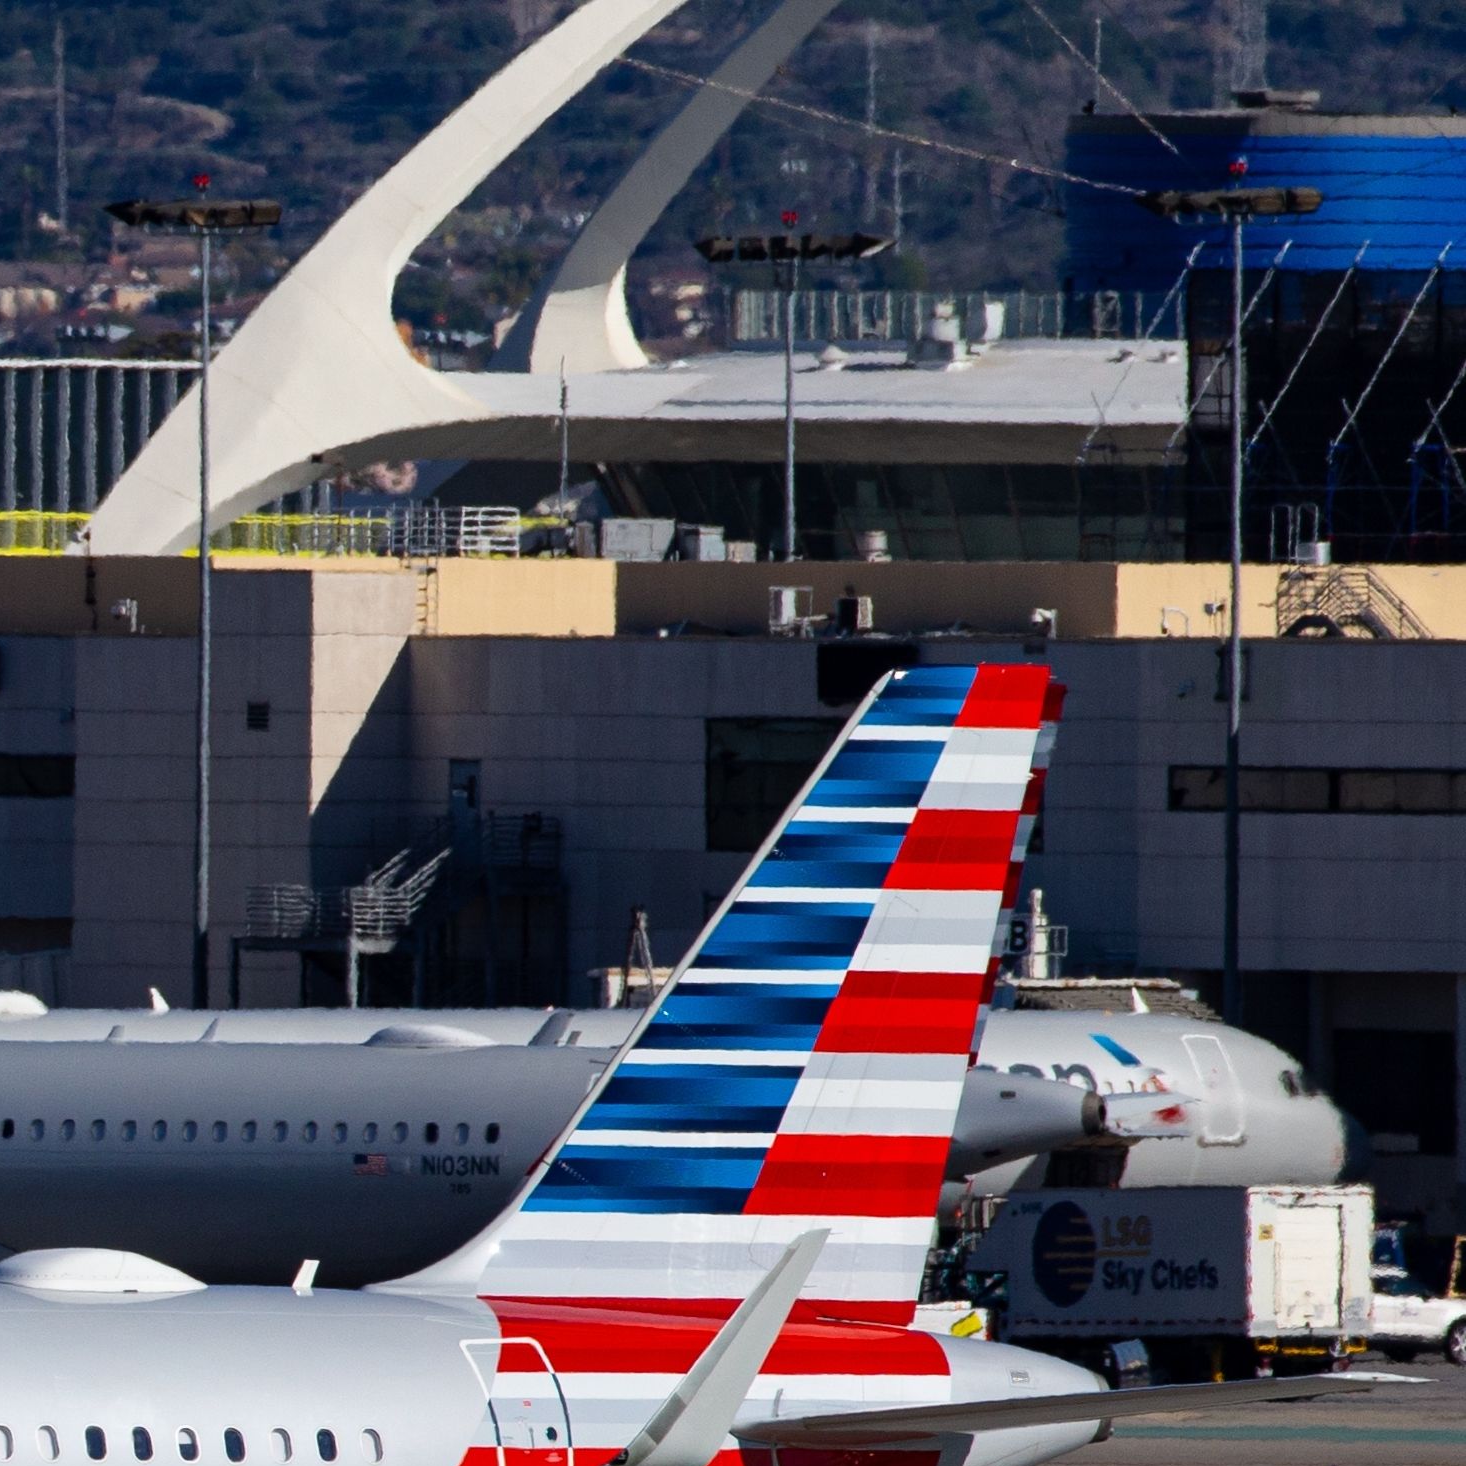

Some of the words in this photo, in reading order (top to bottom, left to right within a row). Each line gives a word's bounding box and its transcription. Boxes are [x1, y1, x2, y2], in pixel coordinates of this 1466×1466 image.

[422, 1155, 500, 1176] N103NN
[1103, 1215, 1153, 1247] LSG
[1101, 1258, 1145, 1295] Sky
[1150, 1258, 1219, 1291] Chefs
